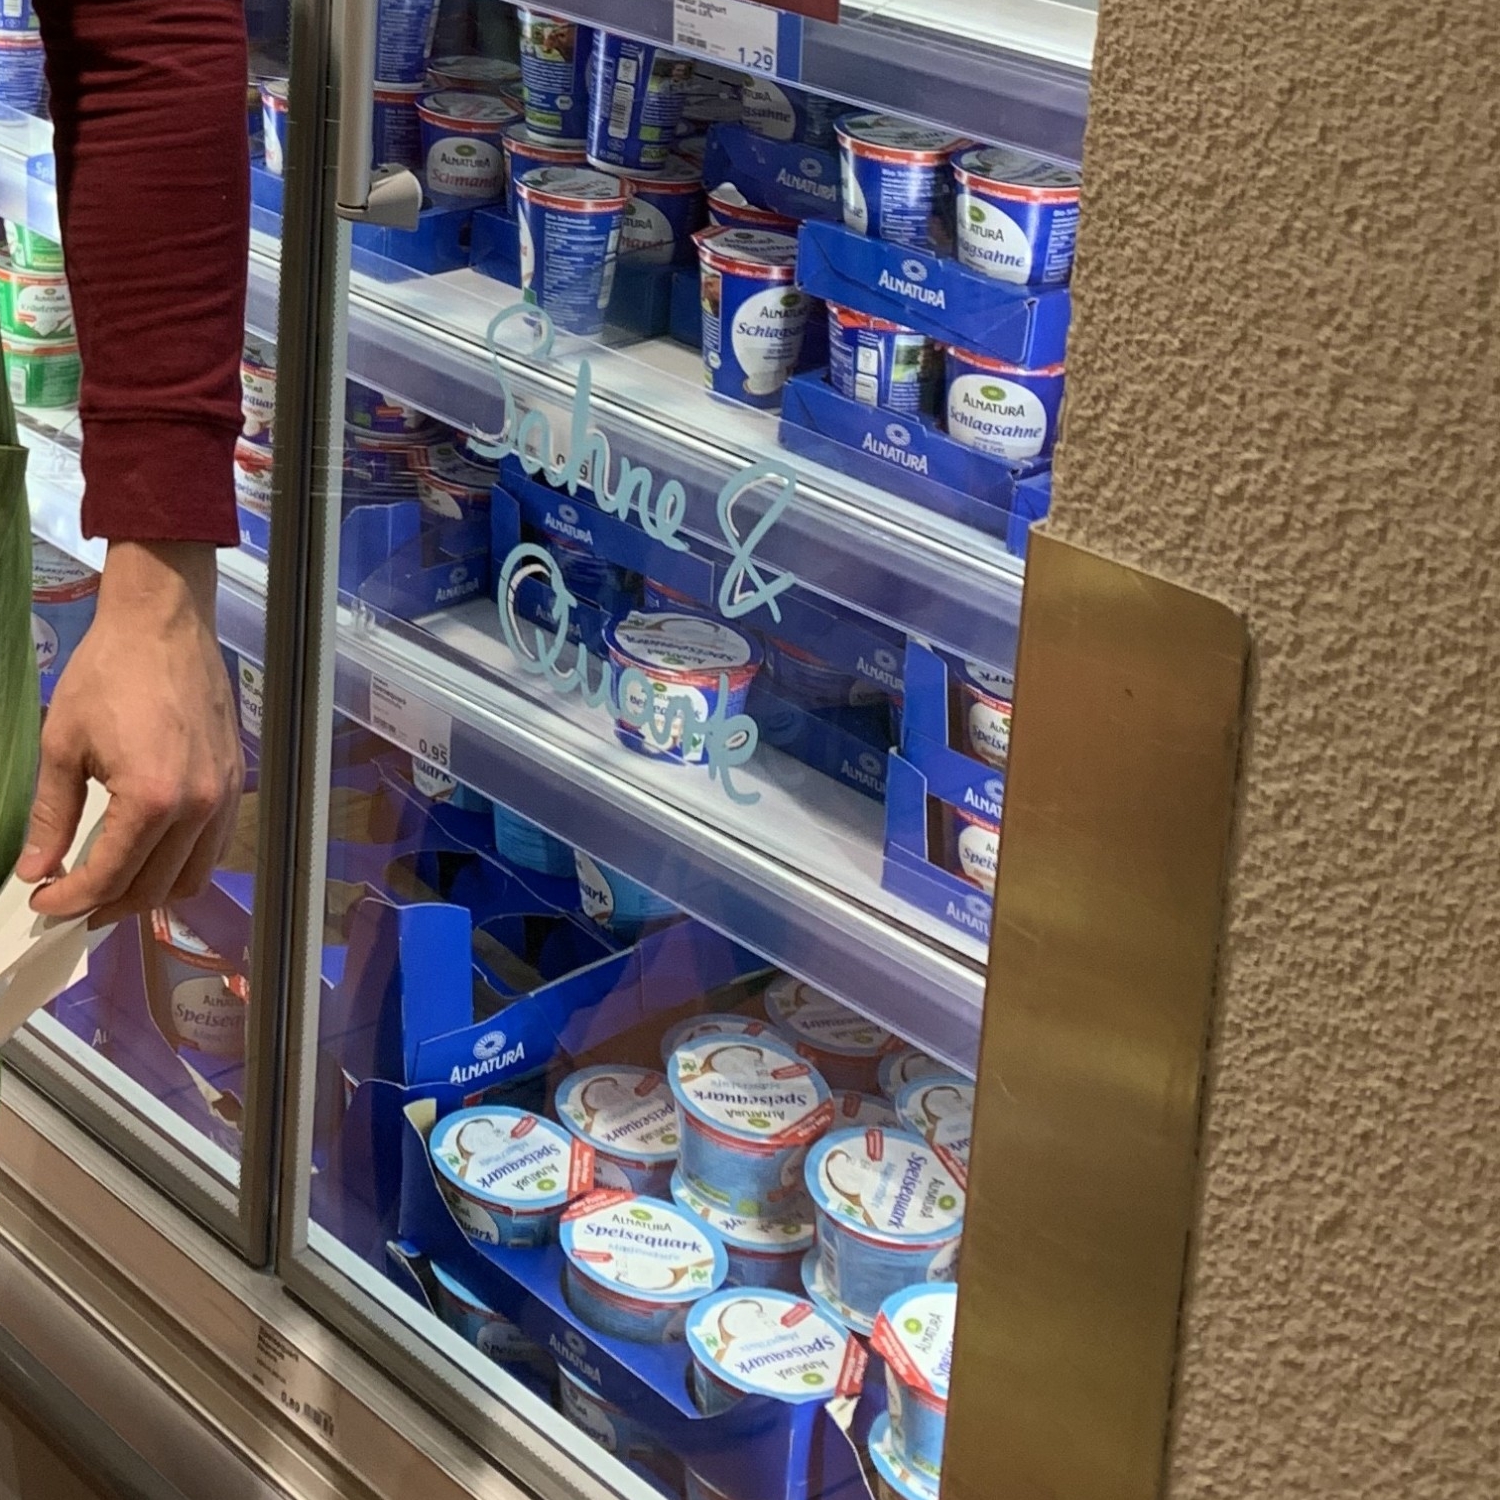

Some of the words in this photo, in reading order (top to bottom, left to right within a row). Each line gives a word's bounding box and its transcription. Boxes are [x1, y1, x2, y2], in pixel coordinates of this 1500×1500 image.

[738, 46, 774, 71] 1,29
[441, 153, 491, 169] ALNATURA
[776, 168, 837, 202] ALNATURA
[878, 269, 946, 310] ALNATURA
[963, 393, 1025, 417] ALNATURA
[465, 302, 690, 552] Sahne
[950, 406, 1042, 438] Schlagsahne
[862, 432, 929, 475] ALNATURA
[545, 512, 593, 545] ALNATURA
[500, 542, 761, 804] Quark
[419, 739, 447, 766] 0,95
[450, 1041, 525, 1084] ALNATURA
[693, 1089, 808, 1106] Speisequark
[725, 1108, 785, 1120] ALNATURA
[477, 1144, 561, 1189] Speisequark
[887, 1151, 928, 1230] Speisequark
[584, 1222, 702, 1254] Speisequark
[612, 1213, 673, 1233] ALNATURA
[914, 1313, 945, 1355] ALNATURA
[735, 1333, 837, 1375] Speisequark
